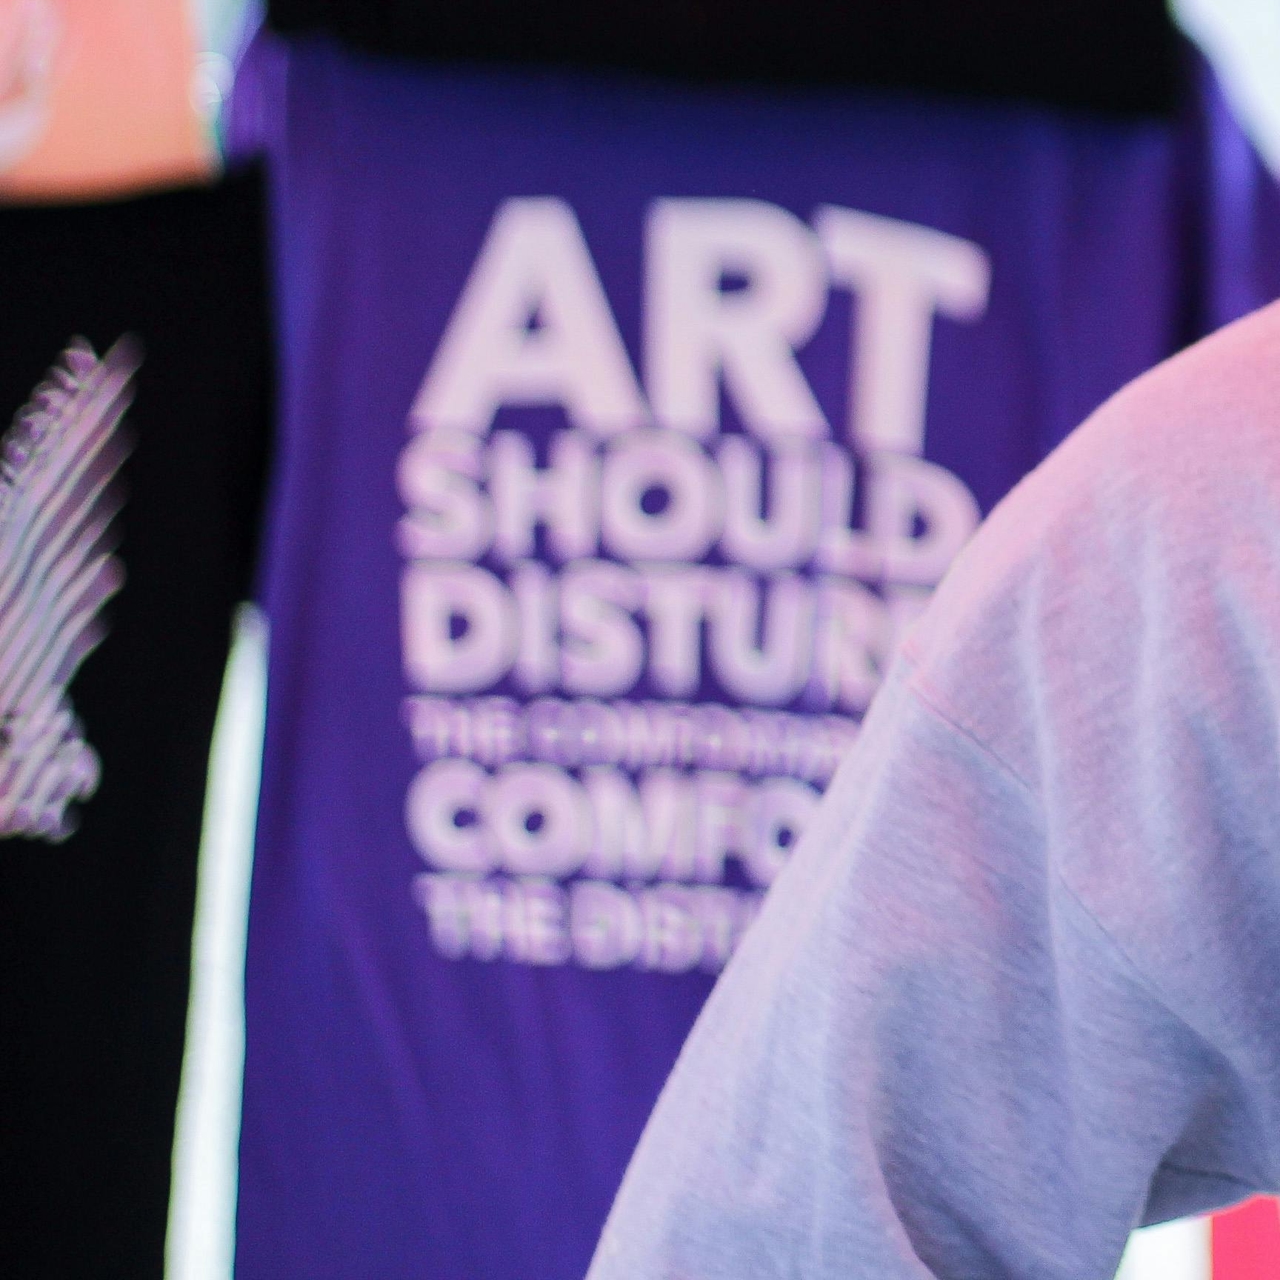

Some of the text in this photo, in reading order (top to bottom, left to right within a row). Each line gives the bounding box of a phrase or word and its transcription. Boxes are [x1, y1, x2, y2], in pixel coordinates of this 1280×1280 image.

[407, 195, 992, 458] ART
[398, 423, 984, 588] SHOULD
[400, 556, 932, 716] DISTUR
[413, 872, 567, 962] THE
